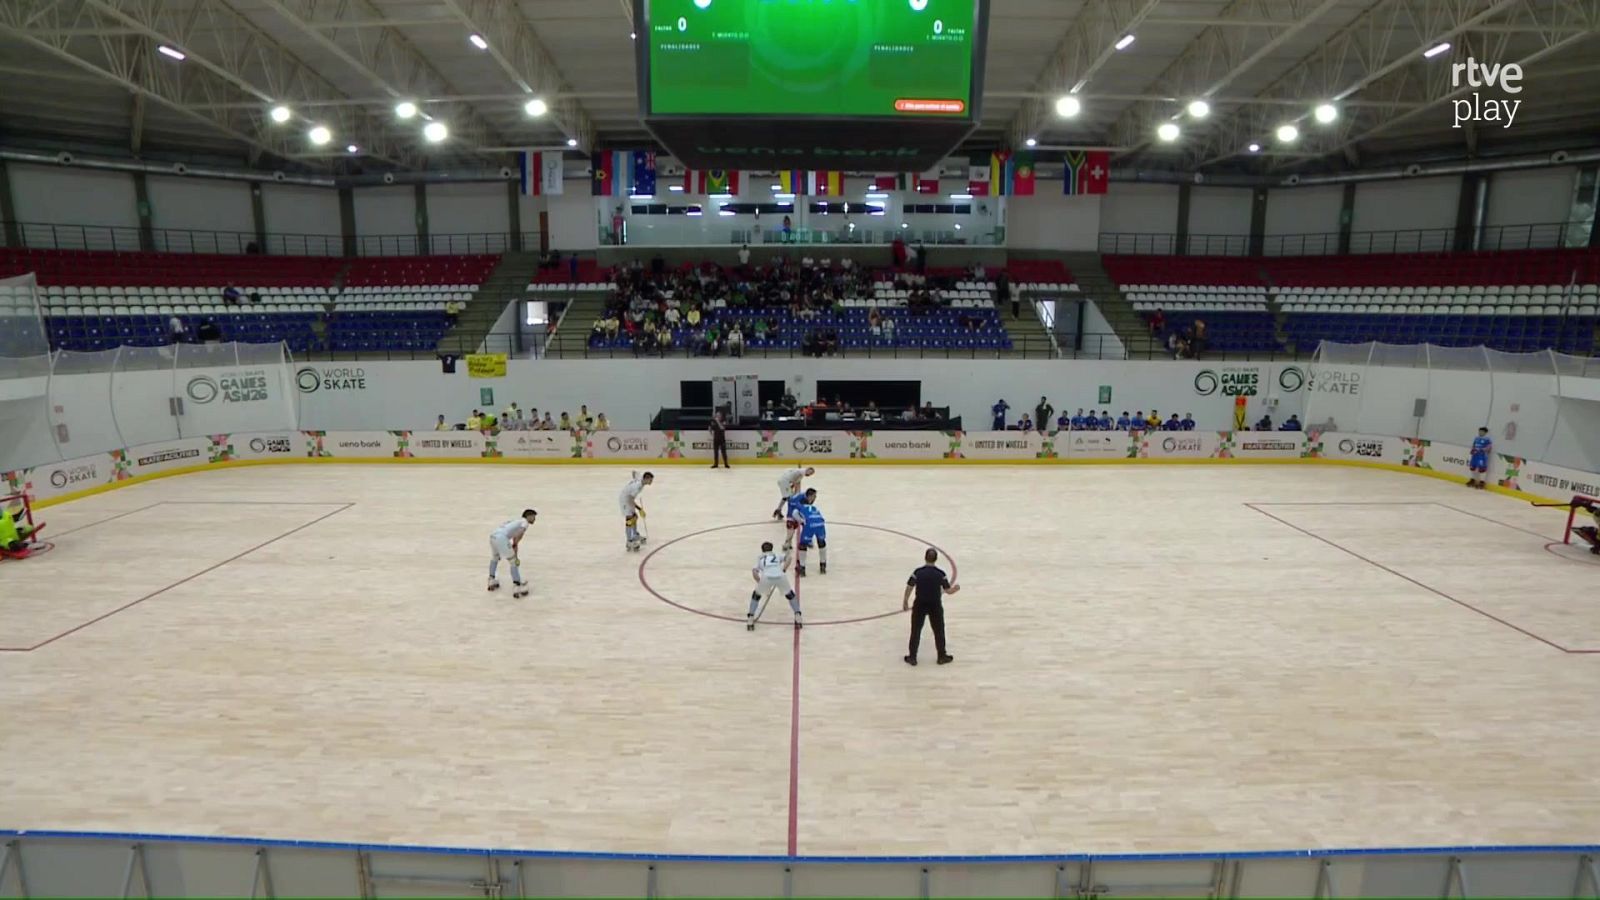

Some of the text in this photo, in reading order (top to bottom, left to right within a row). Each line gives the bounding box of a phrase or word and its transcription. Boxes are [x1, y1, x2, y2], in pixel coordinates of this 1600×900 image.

[678, 17, 687, 31] 0
[934, 20, 942, 34] 0
[323, 367, 365, 378] WORLD
[221, 376, 267, 391] GAMES
[324, 378, 367, 390] SKATE
[1221, 373, 1259, 384] GAMES
[1308, 380, 1360, 395] SKATE
[339, 439, 381, 448] ueno bank
[421, 440, 472, 448] UNITED BY WHEELS
[885, 439, 931, 449] ueno bank
[975, 440, 1028, 449] UNITED BY WHEELS
[1443, 455, 1465, 466] ueno
[69, 471, 97, 483] SKATE
[1534, 474, 1600, 497] UNITED BY WHEELS
